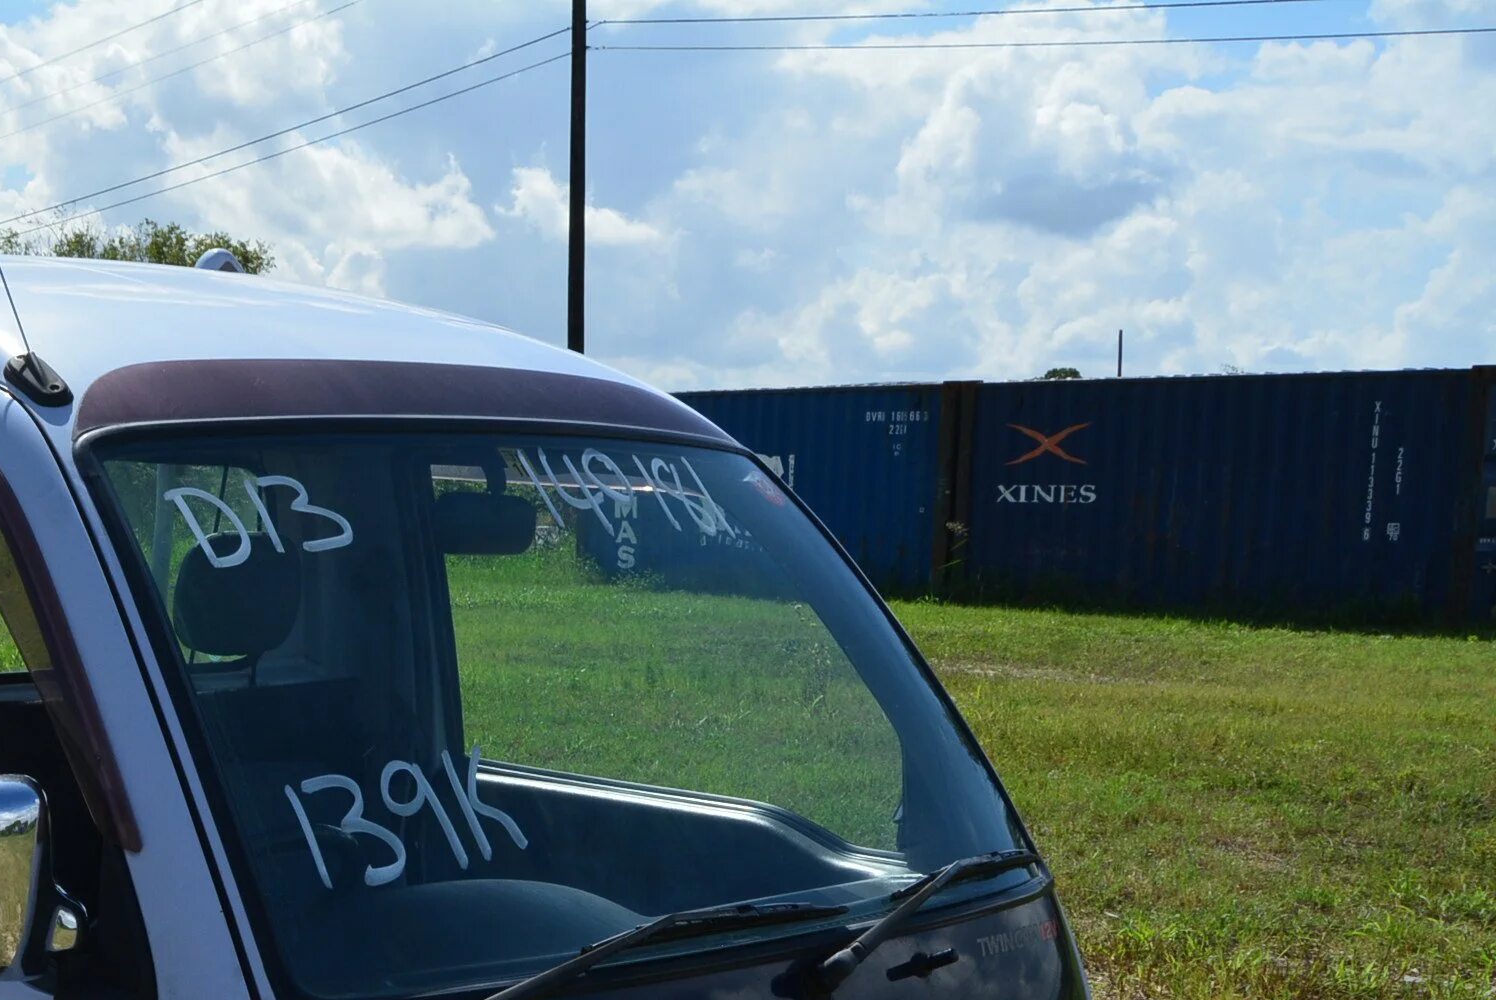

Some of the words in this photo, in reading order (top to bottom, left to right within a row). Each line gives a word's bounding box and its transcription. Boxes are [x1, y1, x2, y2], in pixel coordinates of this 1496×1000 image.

[1371, 400, 1382, 449] XINU
[996, 483, 1098, 504] XINES
[1365, 452, 1376, 524] 113339
